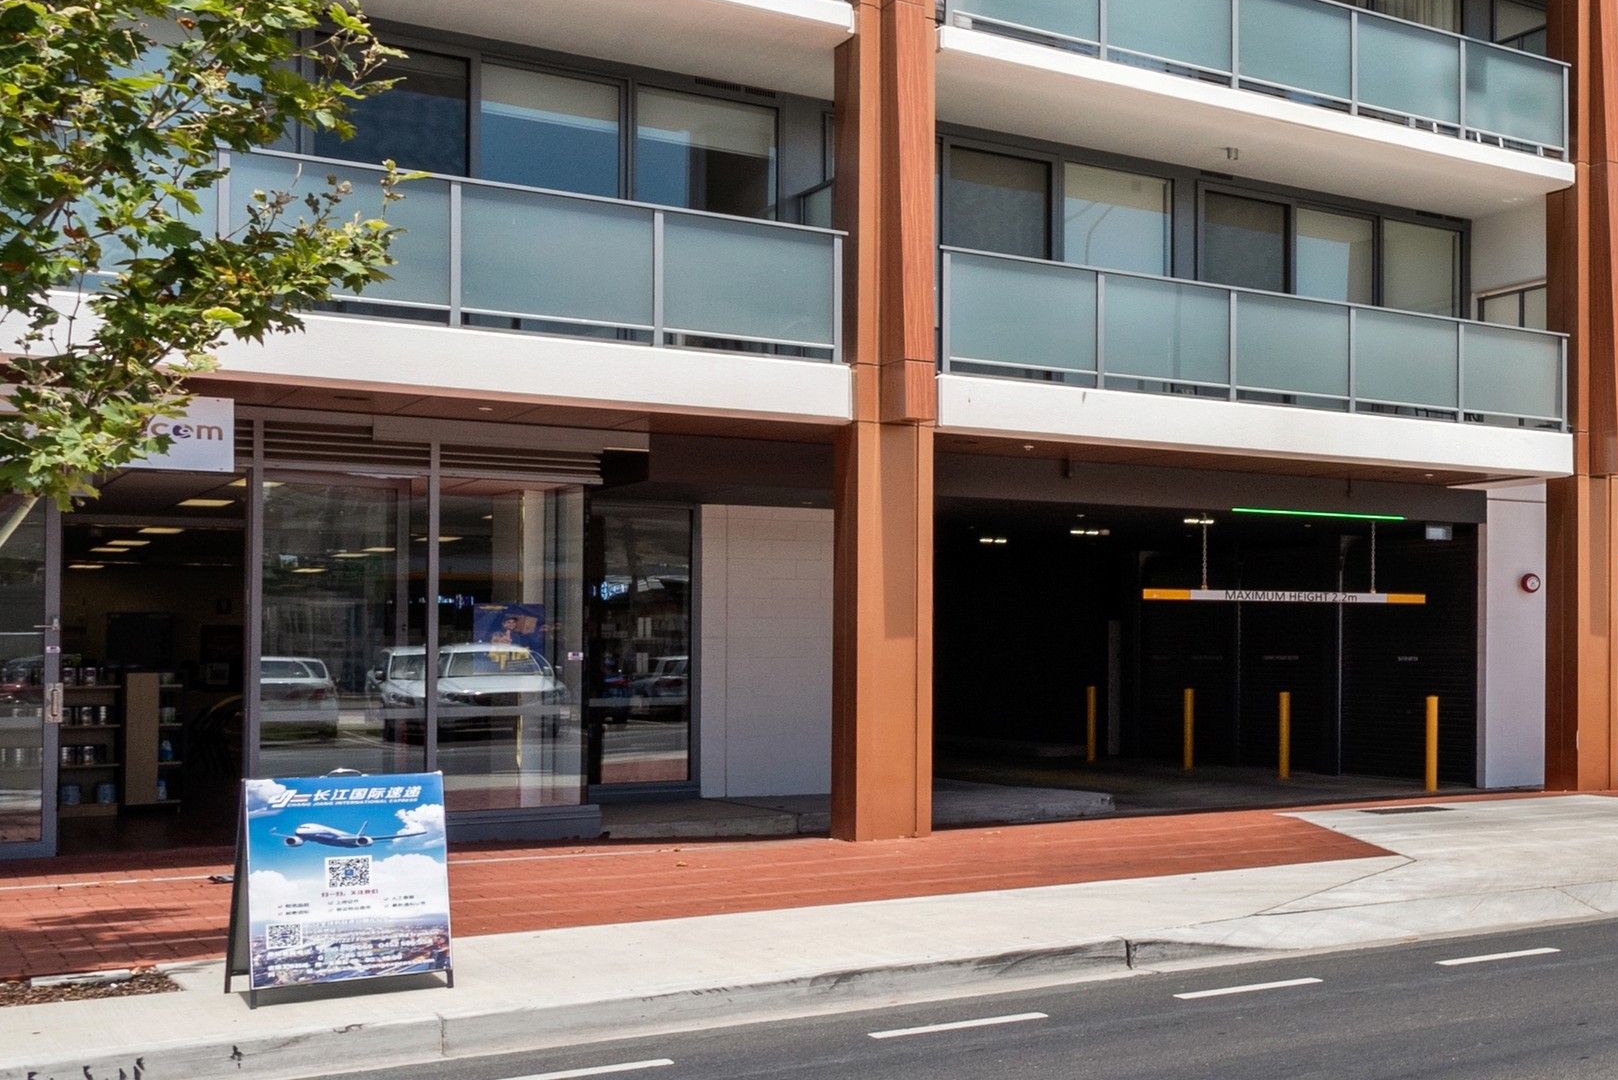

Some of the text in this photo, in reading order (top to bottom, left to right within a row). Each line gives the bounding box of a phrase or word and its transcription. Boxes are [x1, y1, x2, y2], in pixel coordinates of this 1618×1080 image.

[1225, 590, 1357, 602] MAXIMUM HEIGHT 2.2m
[313, 785, 422, 800] 长江国际速递
